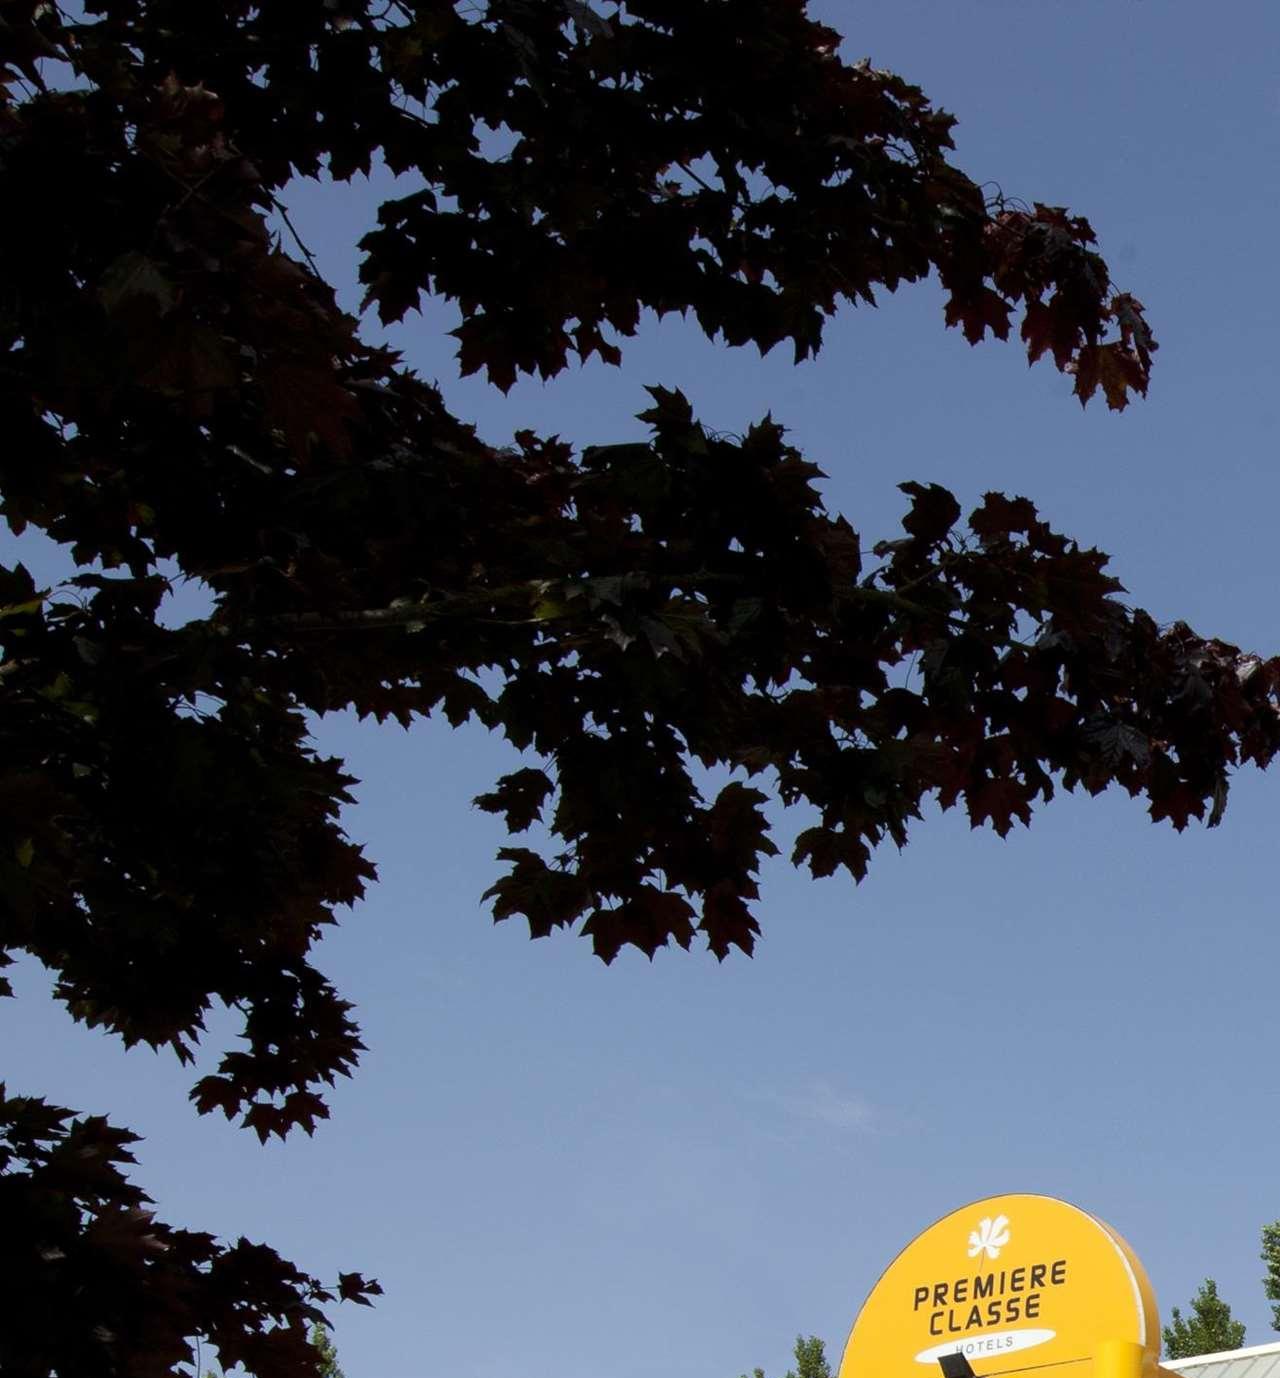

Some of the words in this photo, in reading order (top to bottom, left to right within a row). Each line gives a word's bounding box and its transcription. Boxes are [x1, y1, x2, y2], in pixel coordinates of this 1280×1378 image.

[914, 1260, 1067, 1311] PREMIERE
[929, 1293, 1041, 1336] CLASSE
[955, 1336, 1014, 1354] HOTELS
